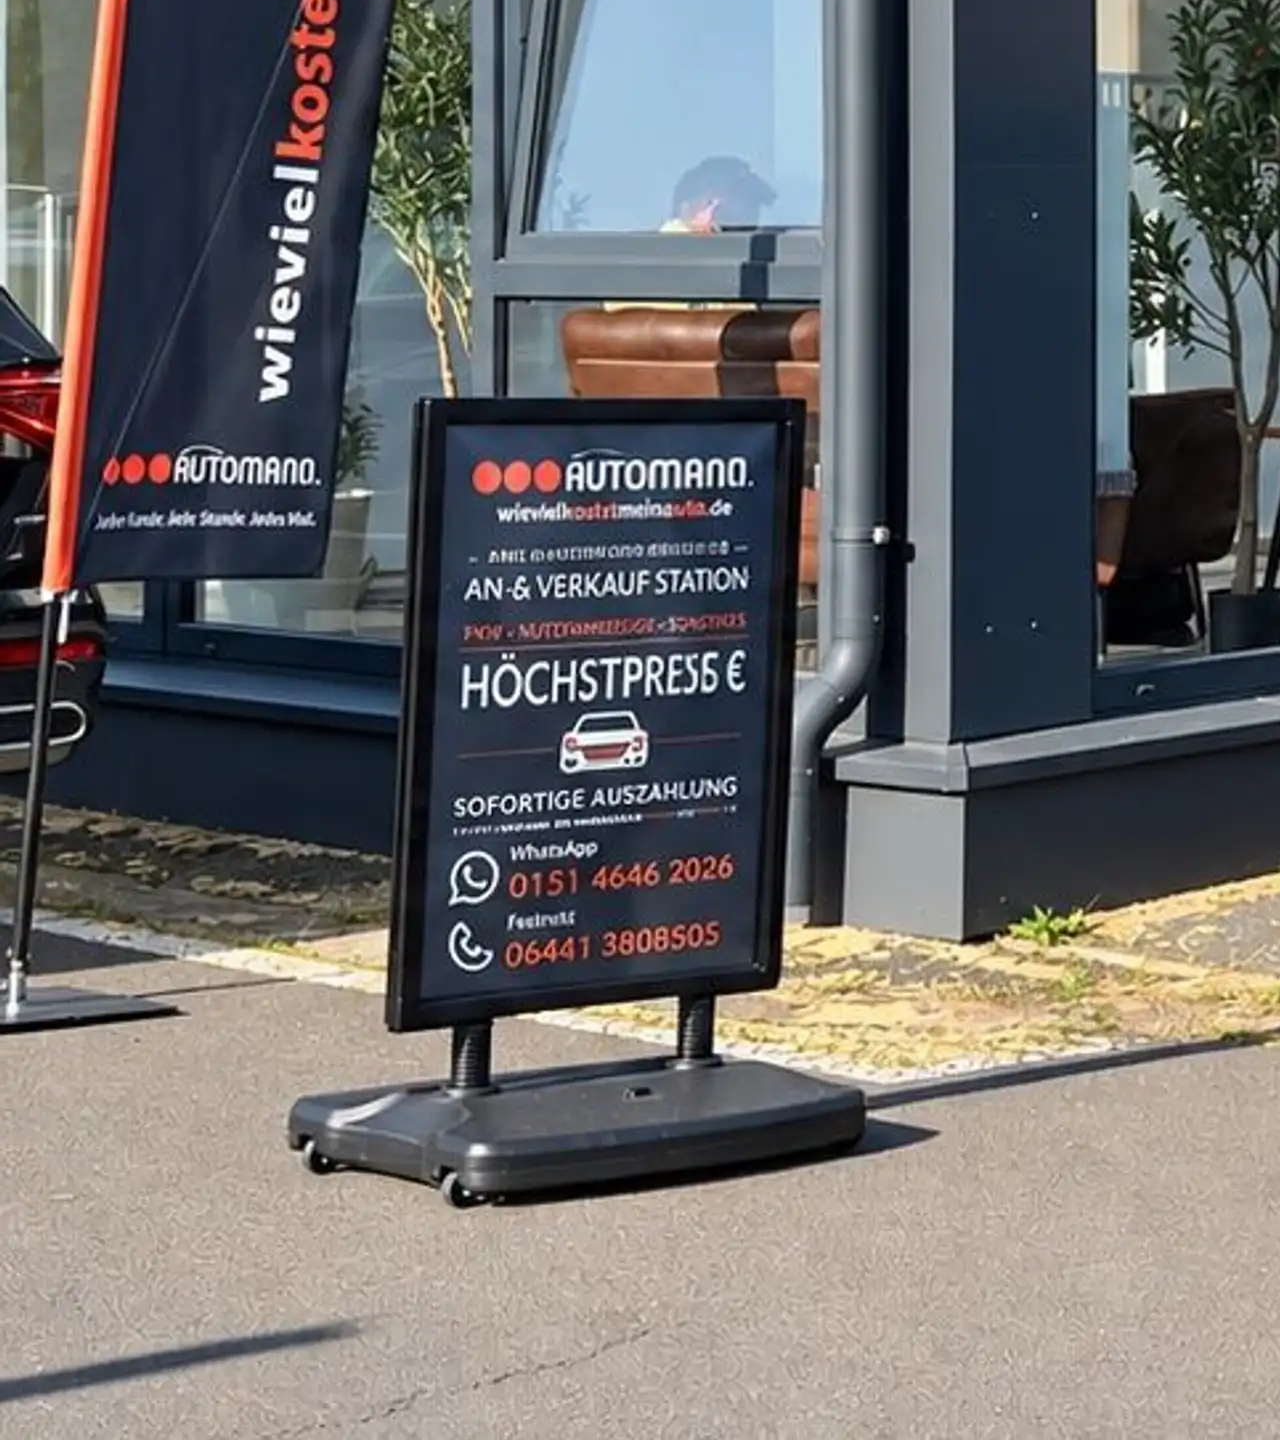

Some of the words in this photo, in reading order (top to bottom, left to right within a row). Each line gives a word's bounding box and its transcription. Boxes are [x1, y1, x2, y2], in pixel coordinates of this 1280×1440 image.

[536, 569, 651, 600] VERKAUF
[655, 566, 751, 594] STATION
[454, 787, 584, 818] SOFORTIGE
[590, 776, 738, 807] AUSZAHLUNG
[508, 869, 580, 900] 0151
[591, 860, 660, 891] 4646
[668, 853, 735, 883] 2026
[504, 935, 591, 969] 06441
[601, 921, 722, 958] 3808505
